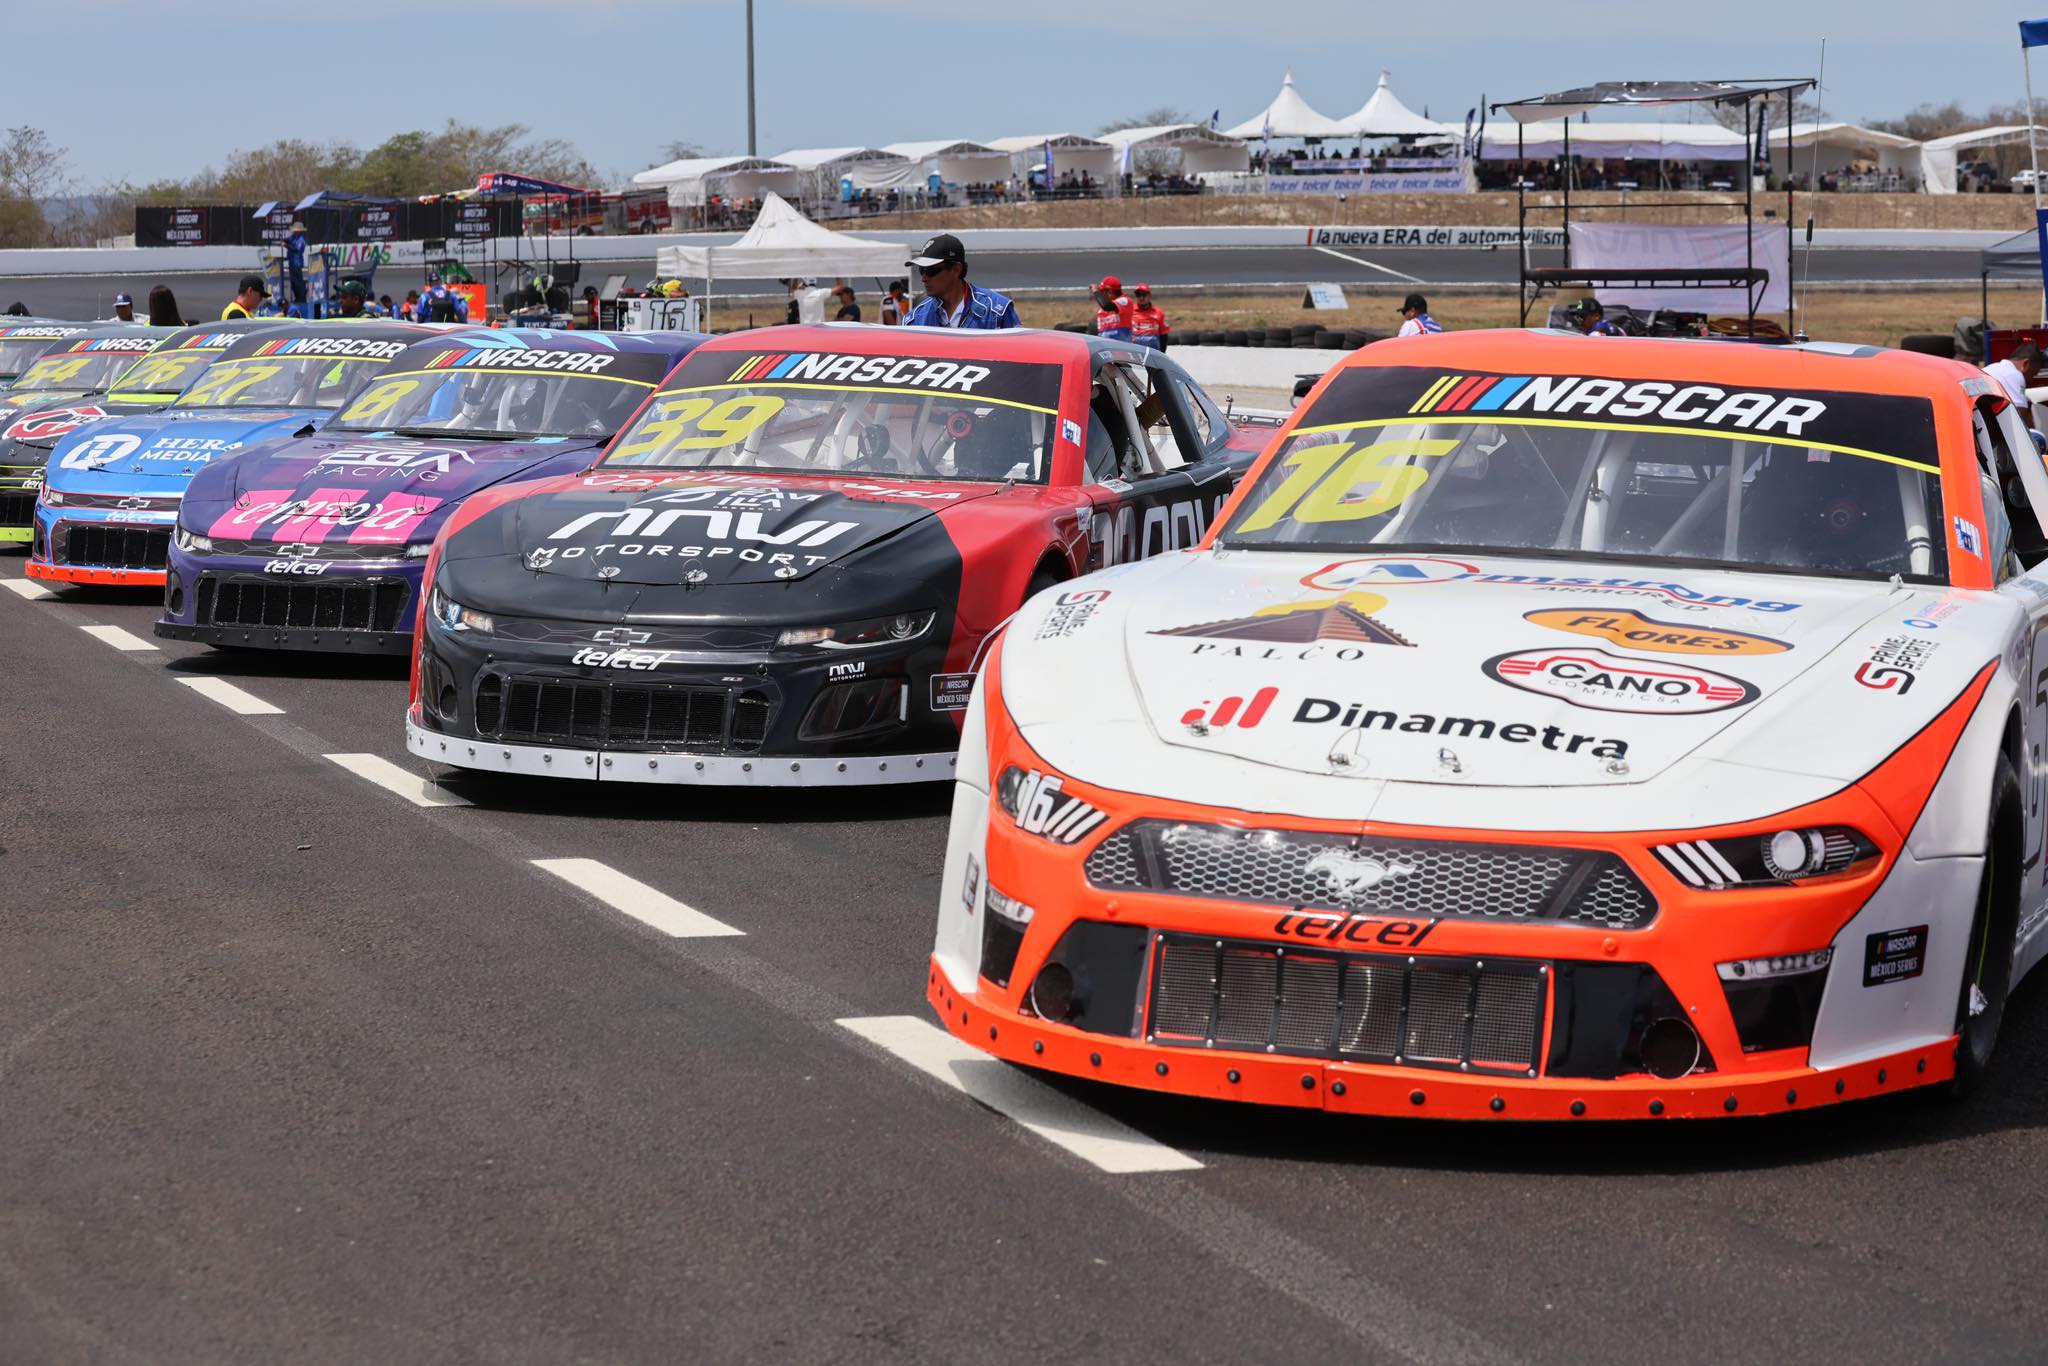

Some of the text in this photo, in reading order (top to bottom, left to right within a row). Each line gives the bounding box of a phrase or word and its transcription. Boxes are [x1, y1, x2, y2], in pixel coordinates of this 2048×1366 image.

[1316, 229, 1330, 245] la
[1332, 231, 1378, 245] nueva
[1383, 229, 1422, 246] ERA
[1426, 228, 1451, 246] del
[286, 338, 408, 358] NASCAR
[472, 349, 615, 373] NASCAR
[13, 358, 94, 388] 54
[112, 356, 201, 389] 26
[176, 366, 283, 405] 27
[785, 353, 991, 393] NASCAR
[341, 380, 419, 421] 8
[1504, 376, 1827, 435] NASCAR
[608, 395, 786, 461] 39
[139, 450, 212, 462] MEDIA
[303, 464, 442, 482] RACING
[1236, 440, 1462, 534] 16
[263, 560, 334, 576] telcel
[531, 543, 830, 567] MOTORSPORT
[1533, 585, 1709, 612] ARMORED
[1566, 615, 1749, 651] FLORES
[572, 647, 673, 671] telcel
[1192, 643, 1365, 661] PALCO
[1893, 637, 1932, 670] SPORTS
[829, 673, 867, 682] MOTORSPORT
[946, 679, 970, 689] NASCAR
[1550, 663, 1692, 696] CANO
[936, 692, 971, 704] MÉXICO SERIE
[1292, 697, 1630, 760] Dinametra
[1014, 768, 1064, 834] 16
[1273, 904, 1446, 948] telcel
[1887, 935, 1917, 953] NASCAR
[1870, 957, 1918, 978] MÉXICO SERIES
